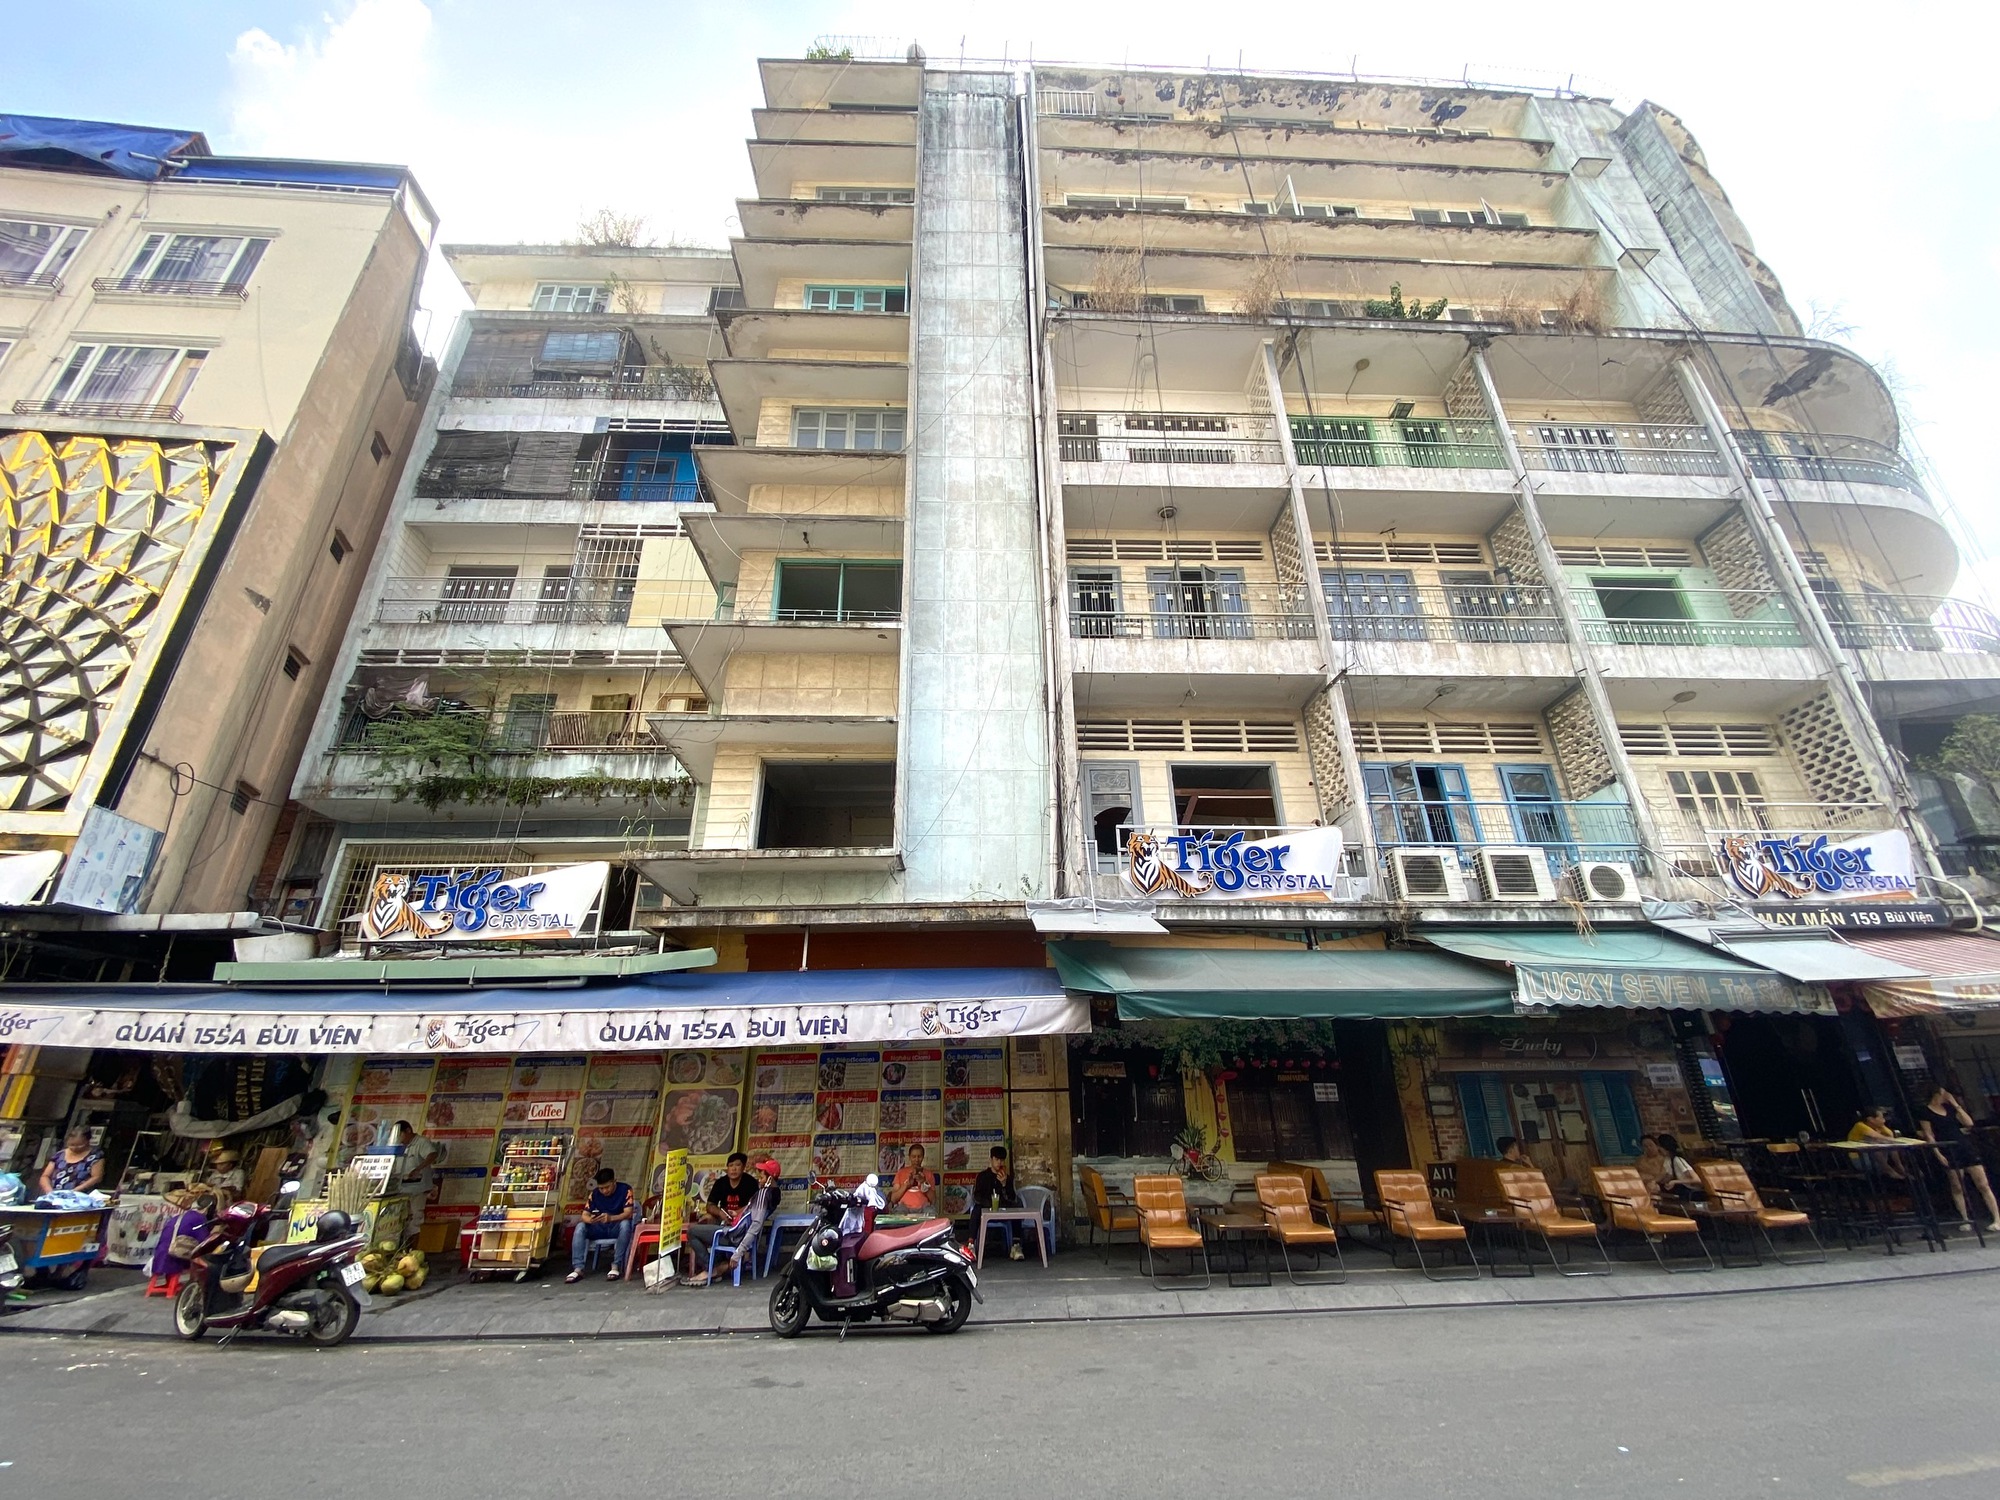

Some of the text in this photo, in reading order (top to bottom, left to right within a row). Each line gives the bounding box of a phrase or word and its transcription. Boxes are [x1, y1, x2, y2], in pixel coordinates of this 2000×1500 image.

[1166, 830, 1291, 891] Tiger
[1757, 834, 1875, 892] Tiger
[1248, 874, 1333, 889] CRYSTAL
[1844, 875, 1916, 890] CRYSTAL
[416, 869, 547, 932] Tiger
[488, 912, 576, 929] CRYSTAL
[1803, 908, 1847, 926] MẮN
[1851, 911, 1882, 926] 159
[1885, 911, 1905, 924] Bùi
[1906, 911, 1934, 925] Viện
[1525, 971, 1613, 1002] LUCKY
[1621, 973, 1711, 1005] SEVEN
[0, 1011, 38, 1036] iger
[599, 1015, 848, 1042] QUÁN 155A BÙI VIỆN
[945, 1005, 1002, 1030] Tiger
[115, 1023, 362, 1049] QUÁN 155A BÙI VIỆN
[455, 1019, 515, 1043] Tiger
[1500, 1037, 1562, 1057] Lucky
[530, 1104, 562, 1118] Coffee
